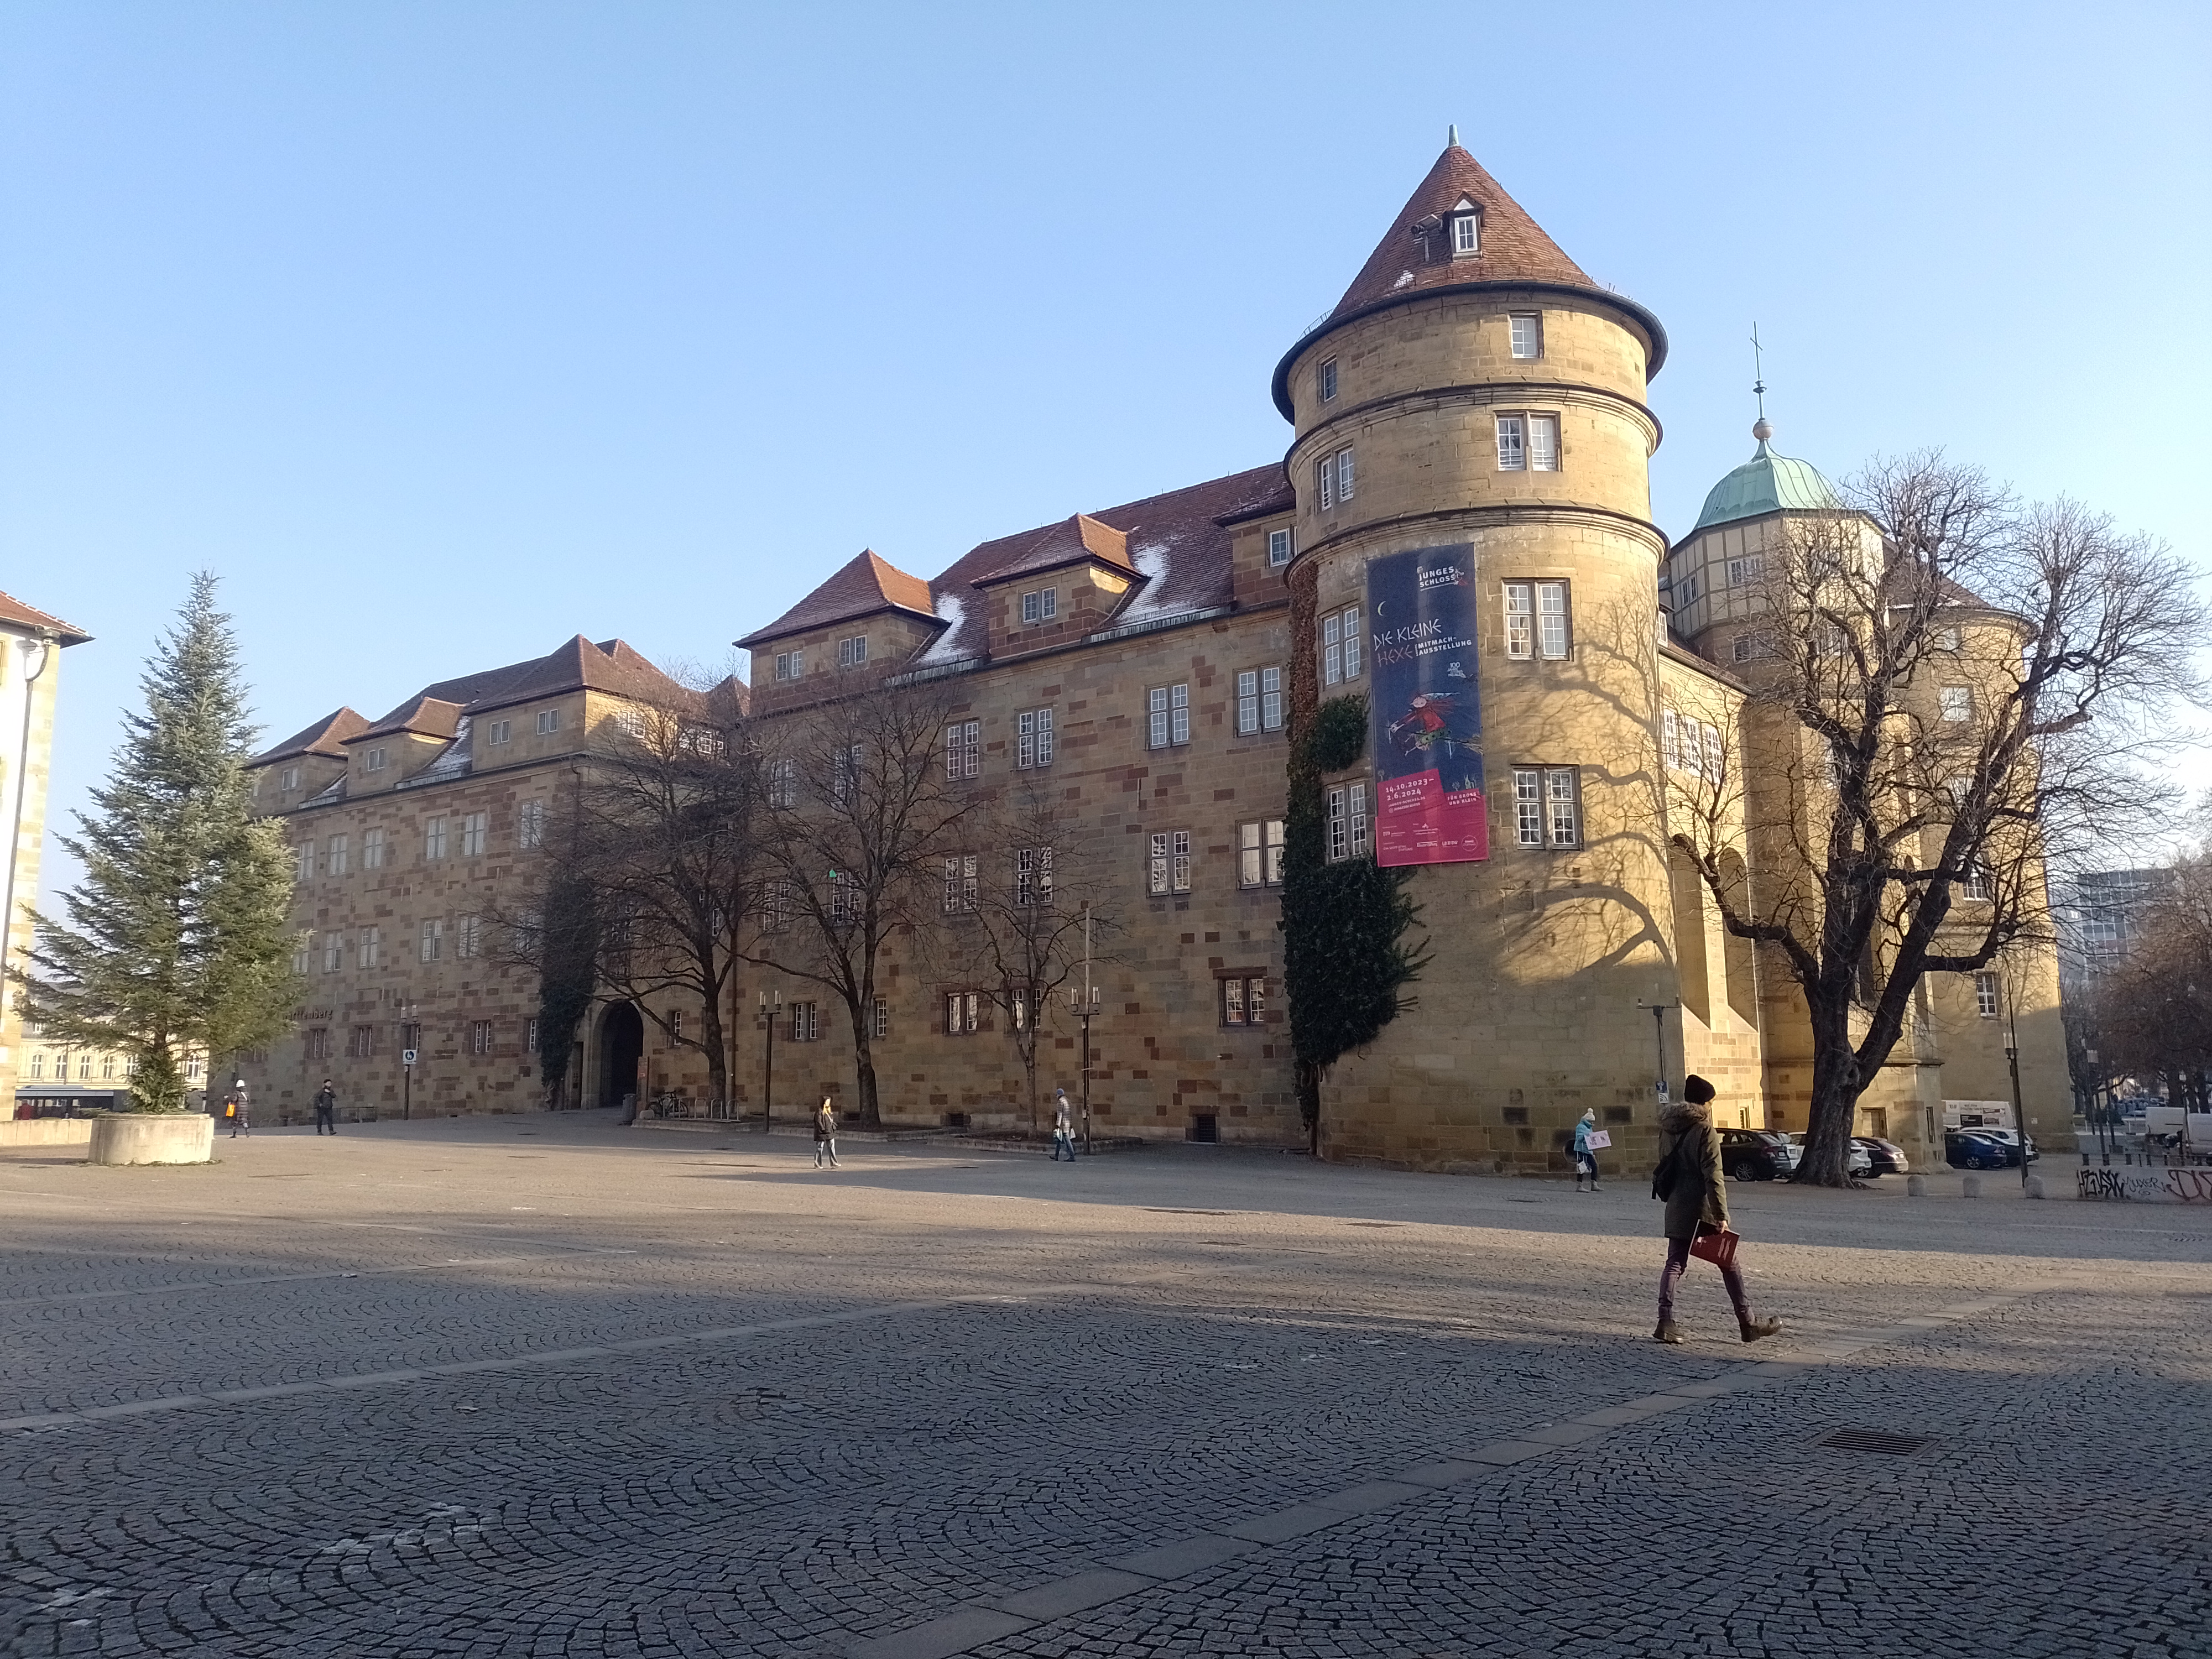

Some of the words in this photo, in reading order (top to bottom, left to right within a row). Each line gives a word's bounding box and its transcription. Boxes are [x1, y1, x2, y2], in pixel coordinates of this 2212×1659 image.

[1419, 566, 1454, 582] JUNGES
[1420, 573, 1455, 587] SCHLOSS
[1373, 630, 1393, 651] DIE
[1397, 618, 1442, 643] KLEINE
[1418, 636, 1457, 649] MITMACH-
[1378, 644, 1413, 667] HEXE
[1418, 639, 1472, 656] AUSSTELLUNG
[1386, 788, 1422, 801] 2.6.2024
